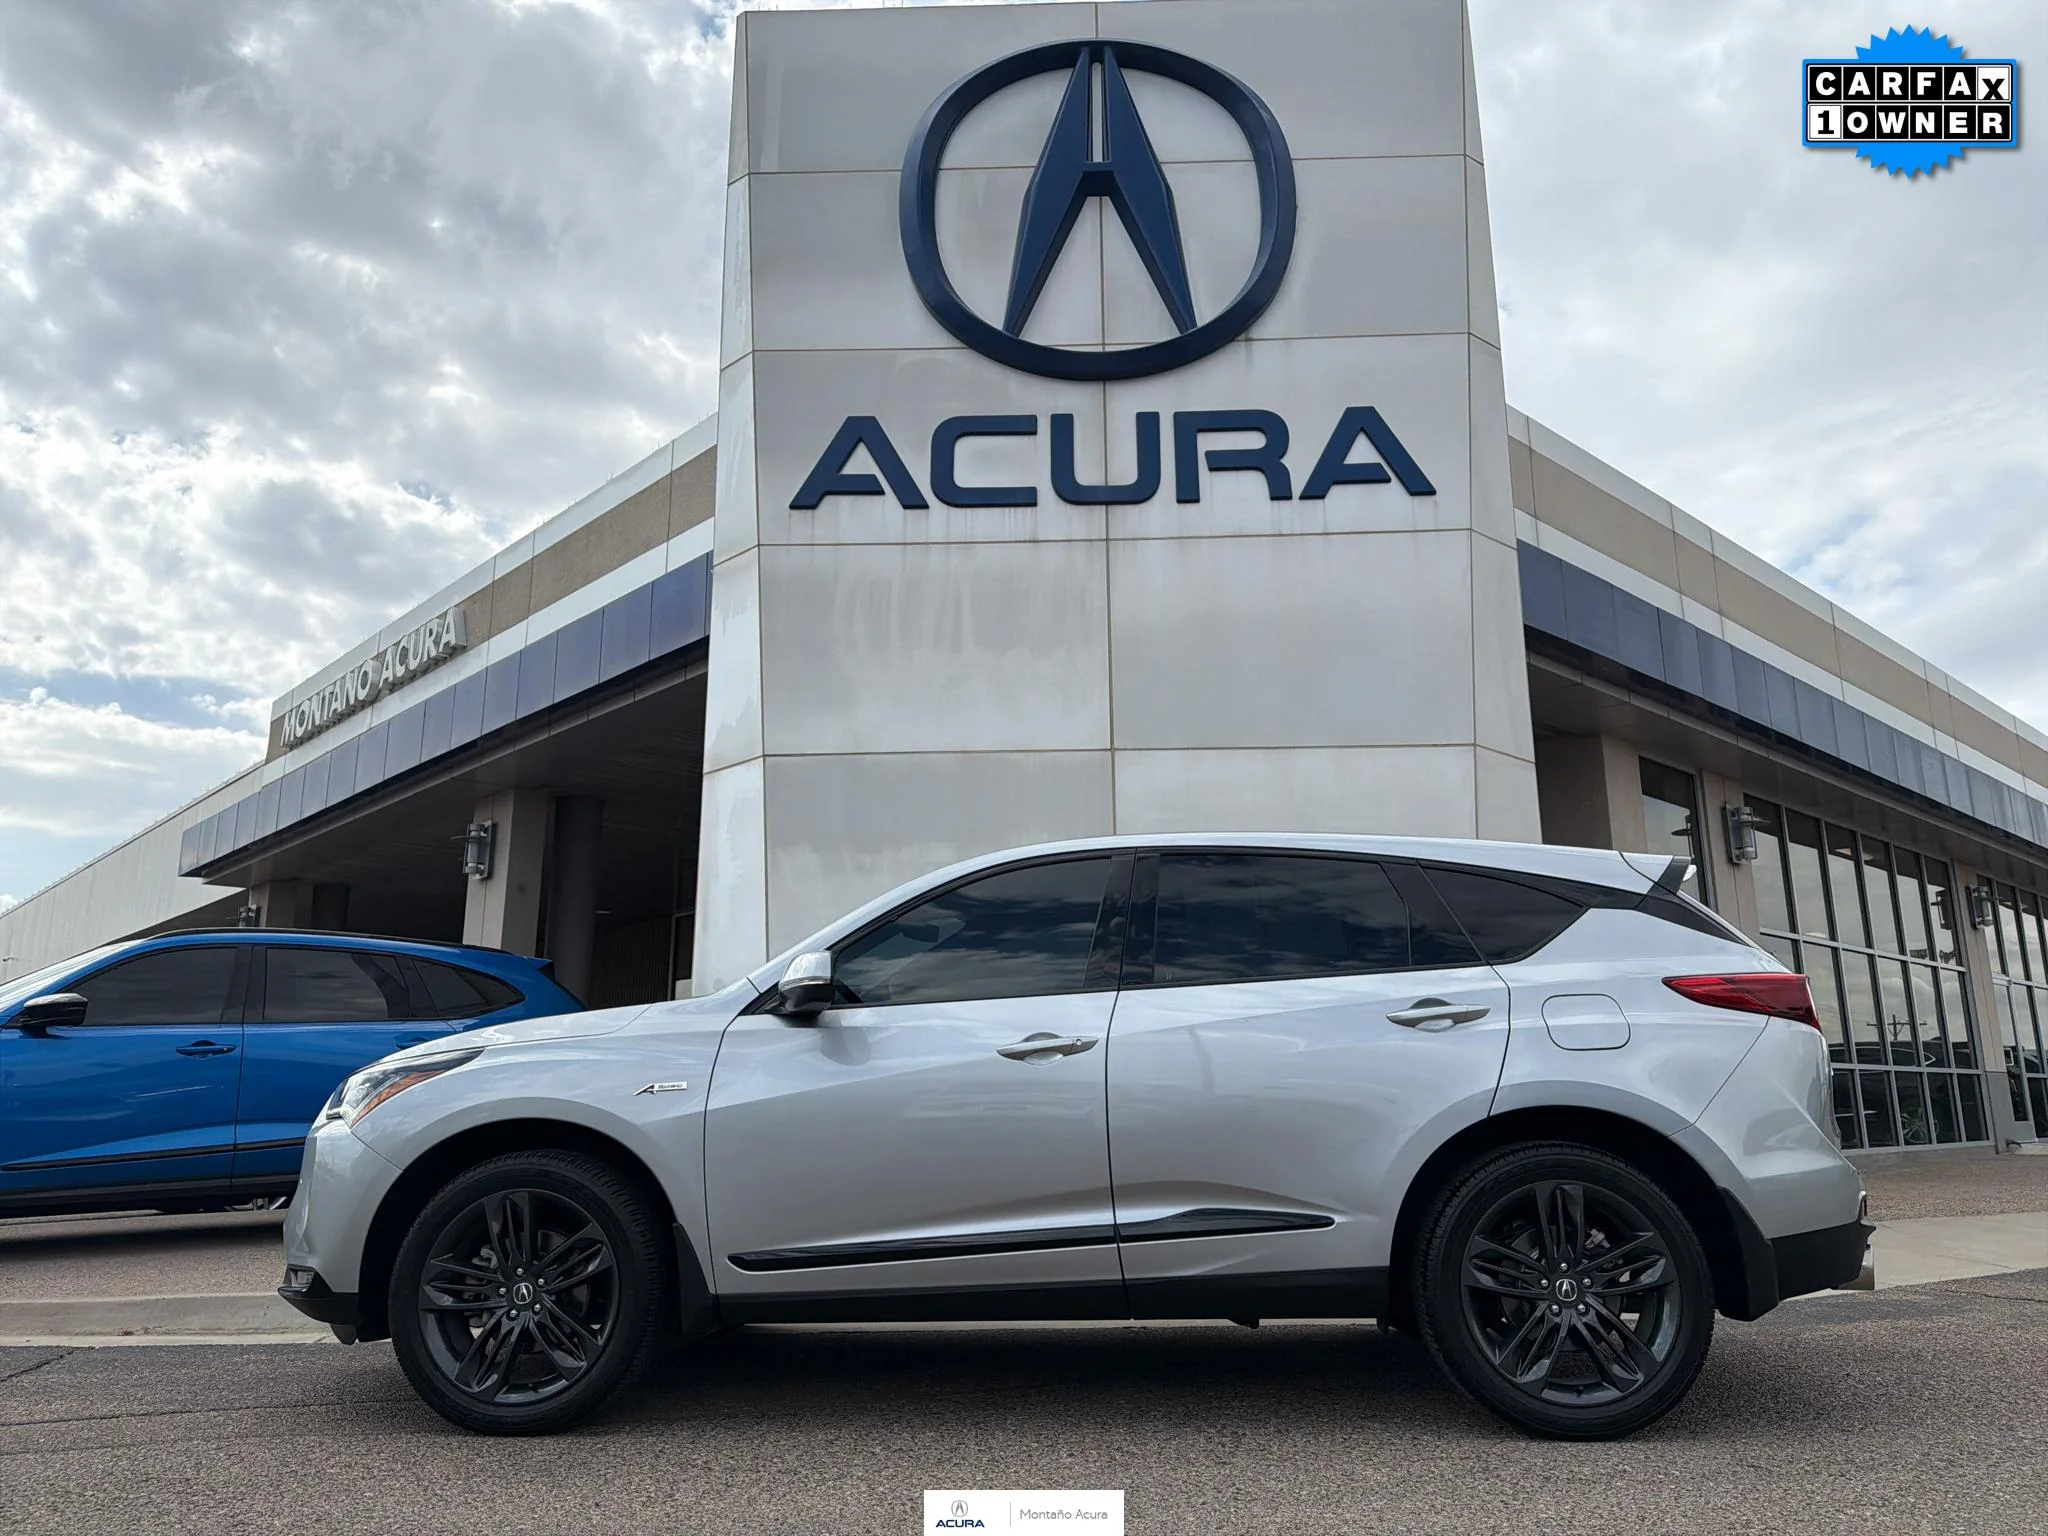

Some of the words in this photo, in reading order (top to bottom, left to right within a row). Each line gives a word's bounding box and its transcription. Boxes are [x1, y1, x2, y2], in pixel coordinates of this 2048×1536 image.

[789, 405, 1437, 510] ACURA
[280, 658, 381, 748] MONTANO
[379, 606, 467, 690] ACURA
